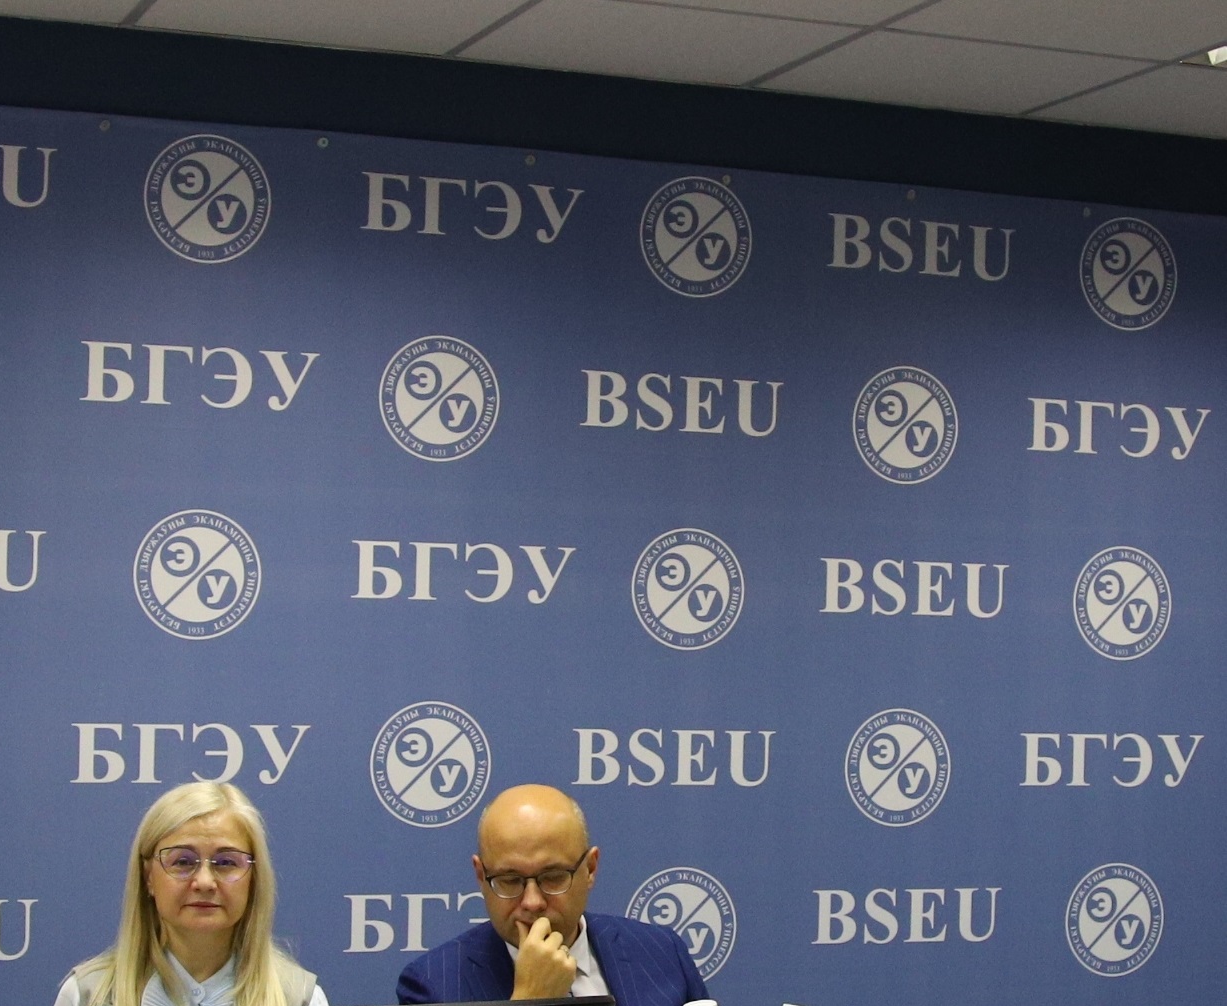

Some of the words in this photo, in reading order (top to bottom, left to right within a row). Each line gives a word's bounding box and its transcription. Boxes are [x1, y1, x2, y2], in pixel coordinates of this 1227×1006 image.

[360, 172, 585, 244] БГЭУ
[828, 212, 1015, 281] BSEU
[80, 341, 320, 411] БГЭУ
[580, 370, 784, 436] BSEU
[1027, 398, 1211, 459] БГЭУ
[351, 540, 576, 603] БГЭУ
[820, 558, 1010, 618] BSEU
[71, 724, 311, 784] БГЭУ
[572, 728, 777, 787] BSEU
[1020, 733, 1205, 787] БГЭУ
[812, 887, 1002, 944] BSEU
